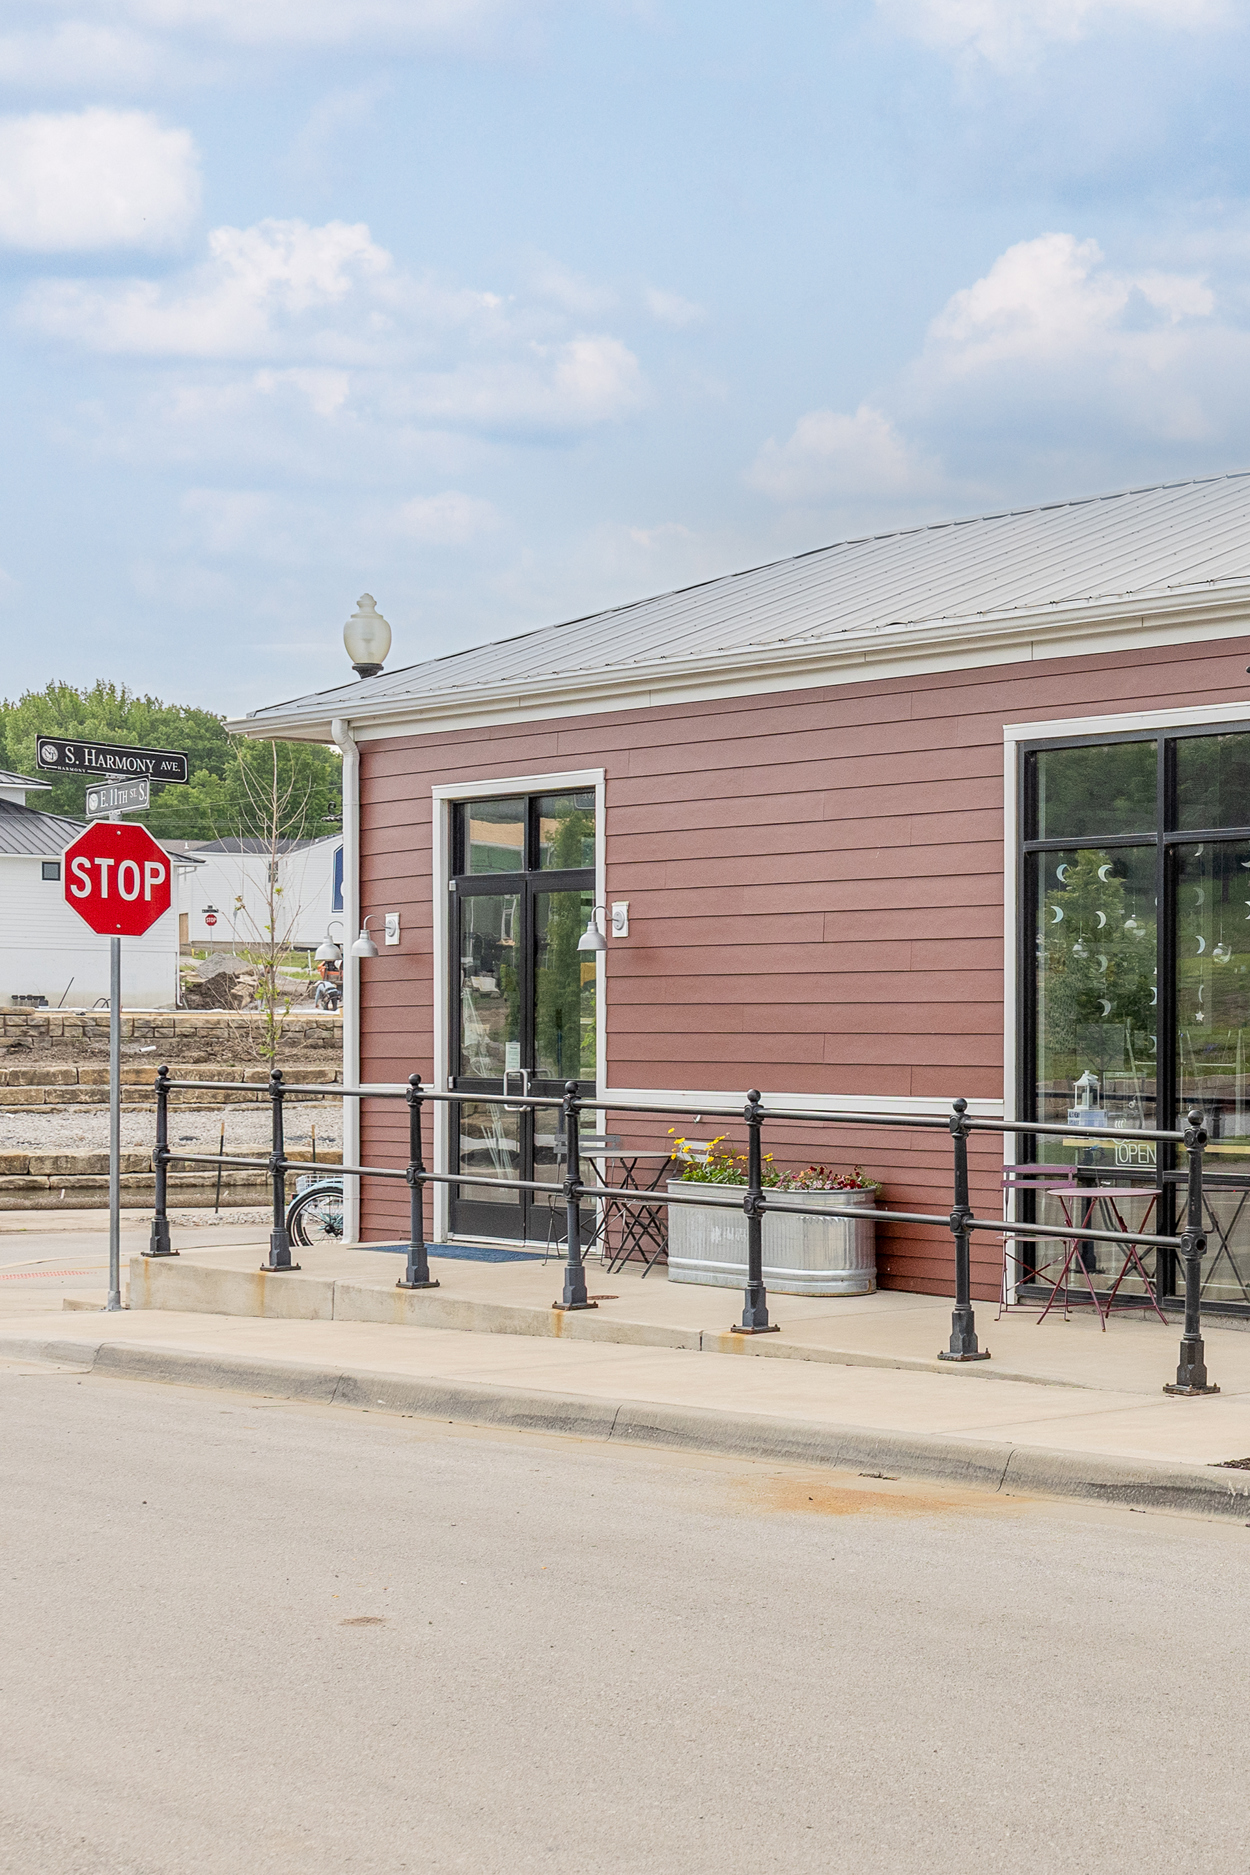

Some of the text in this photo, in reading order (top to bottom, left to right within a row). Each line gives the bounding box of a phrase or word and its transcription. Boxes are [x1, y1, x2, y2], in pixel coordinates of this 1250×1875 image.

[65, 746, 181, 773] S. HARMONY AVE.
[100, 790, 109, 807] E.
[110, 788, 128, 806] 11TH
[139, 783, 147, 801] S.
[70, 856, 166, 902] STOP
[1118, 1144, 1157, 1164] OPEN
